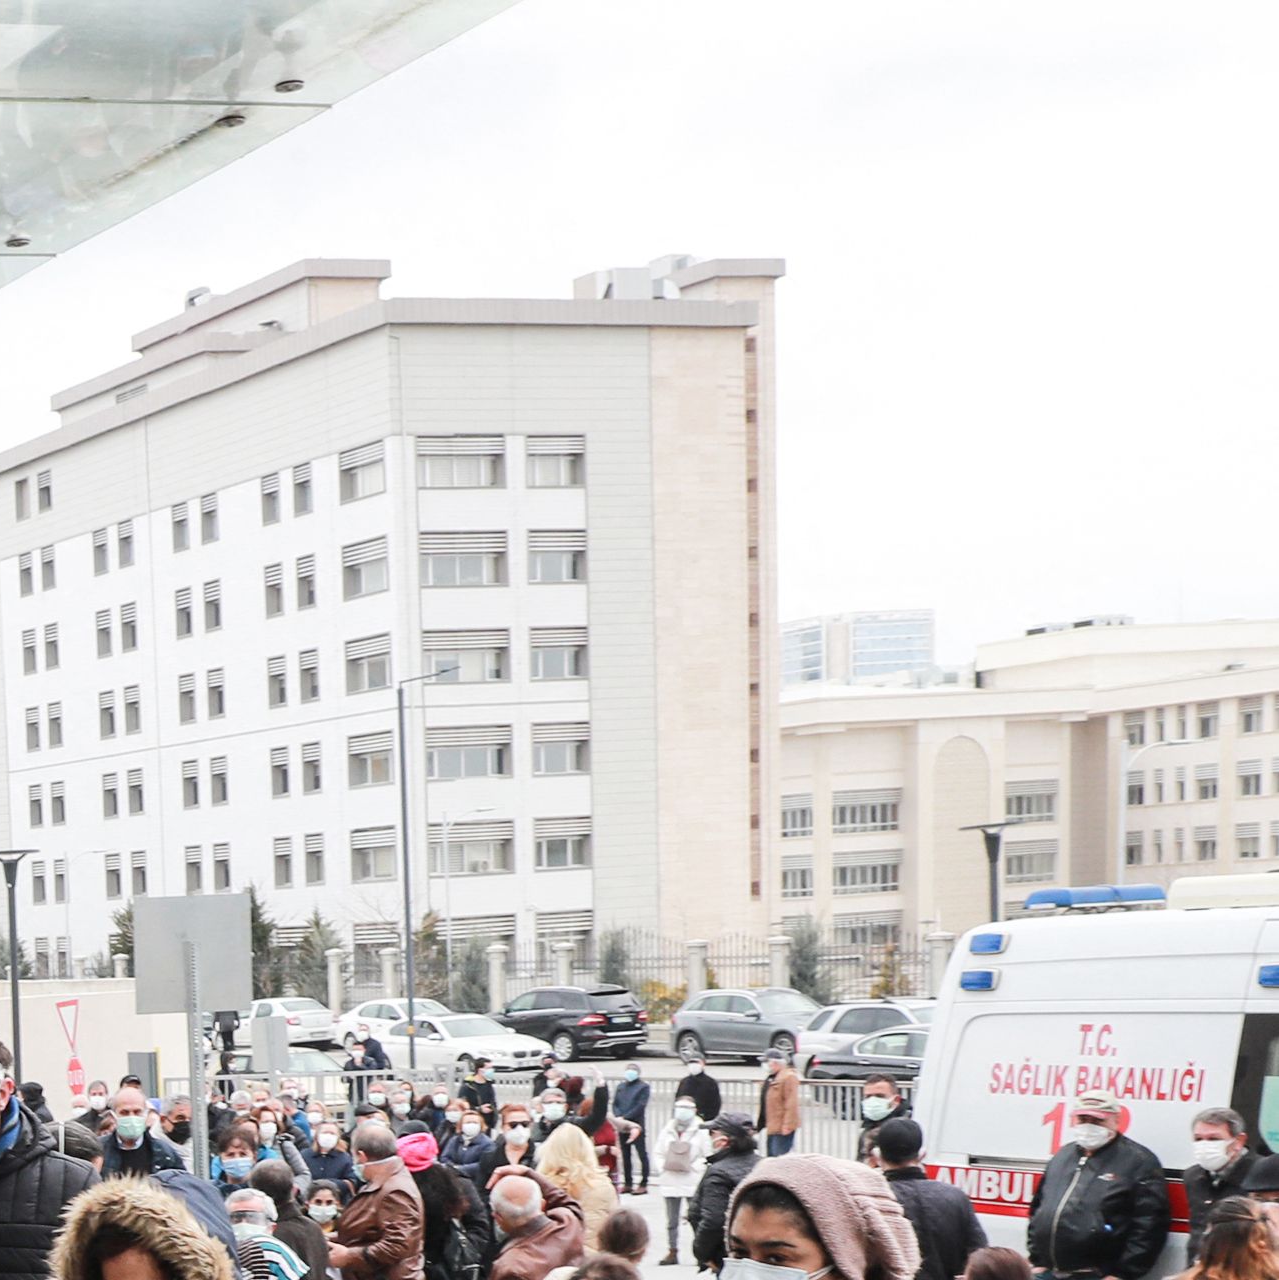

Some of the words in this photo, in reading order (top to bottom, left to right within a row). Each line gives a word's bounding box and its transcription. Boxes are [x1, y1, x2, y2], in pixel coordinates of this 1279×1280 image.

[1078, 1024, 1117, 1057] T.C.
[989, 1057, 1069, 1096] SAĞLIK
[1075, 1061, 1205, 1102] BAKANLIĞI
[935, 1167, 1035, 1203] AMBUL
